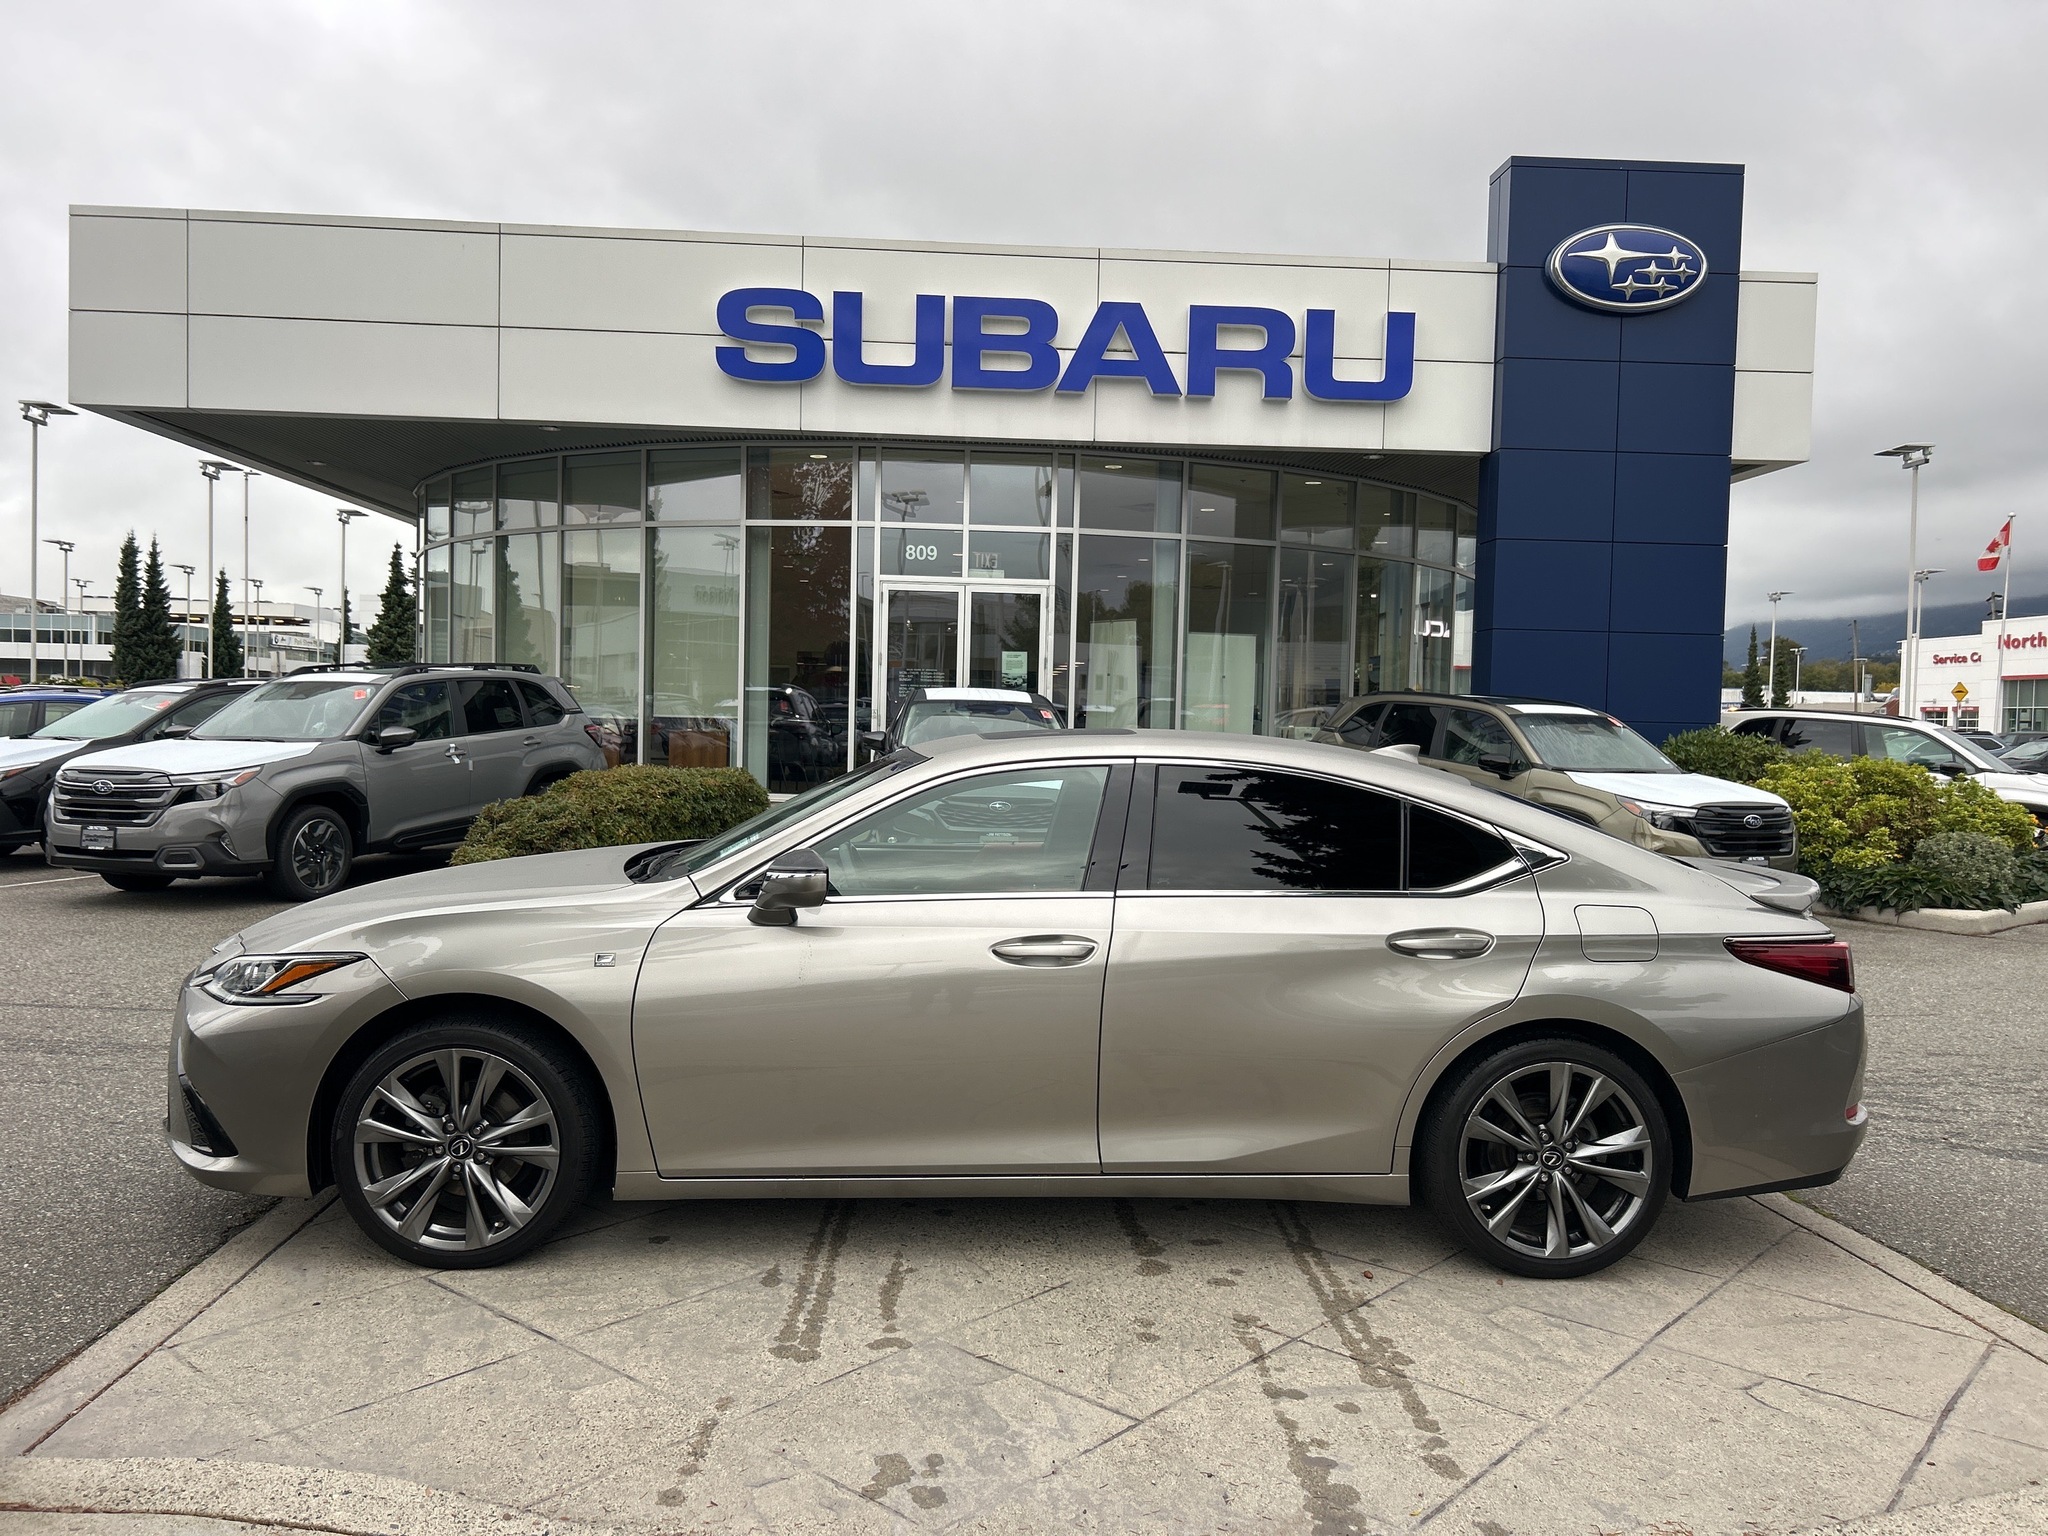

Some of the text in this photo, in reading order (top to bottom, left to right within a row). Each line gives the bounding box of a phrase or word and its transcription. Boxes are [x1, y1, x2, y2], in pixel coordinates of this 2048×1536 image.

[715, 287, 1416, 403] SUBARU
[905, 544, 938, 561] 809
[1997, 632, 2047, 649] North
[1933, 653, 1967, 664] Service
